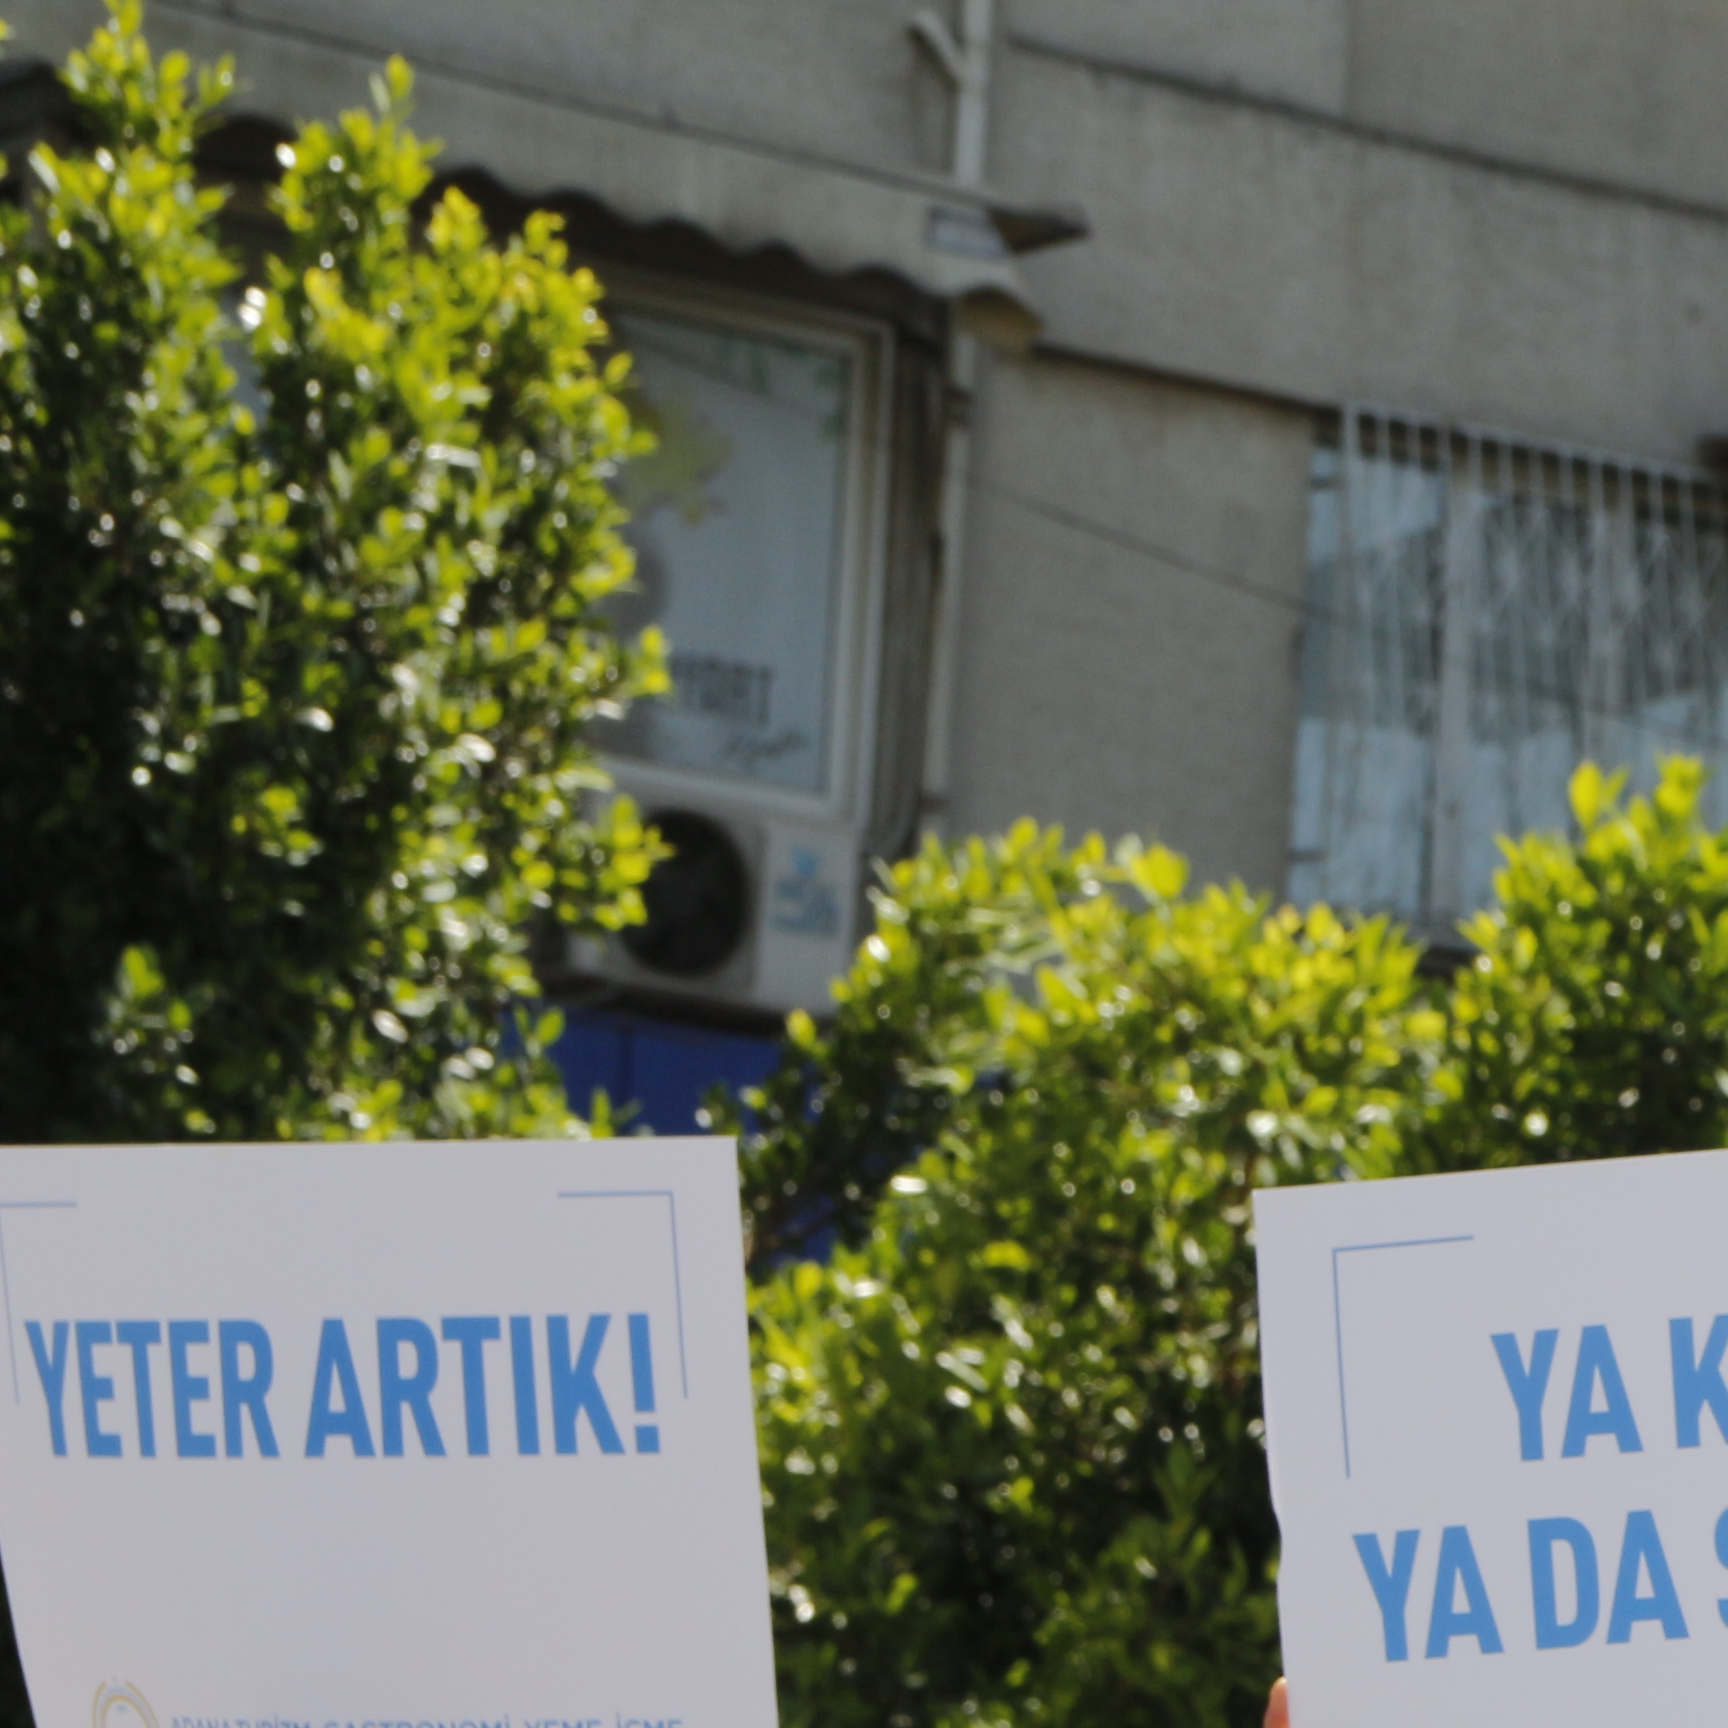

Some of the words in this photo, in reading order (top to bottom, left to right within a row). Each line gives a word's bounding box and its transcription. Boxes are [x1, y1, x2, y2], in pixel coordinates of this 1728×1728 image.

[26, 1319, 280, 1457] YETER
[306, 1313, 660, 1457] ARTIK!
[1492, 1325, 1643, 1460] YA
[1354, 1525, 1503, 1661] YA
[1529, 1510, 1689, 1649] DA
